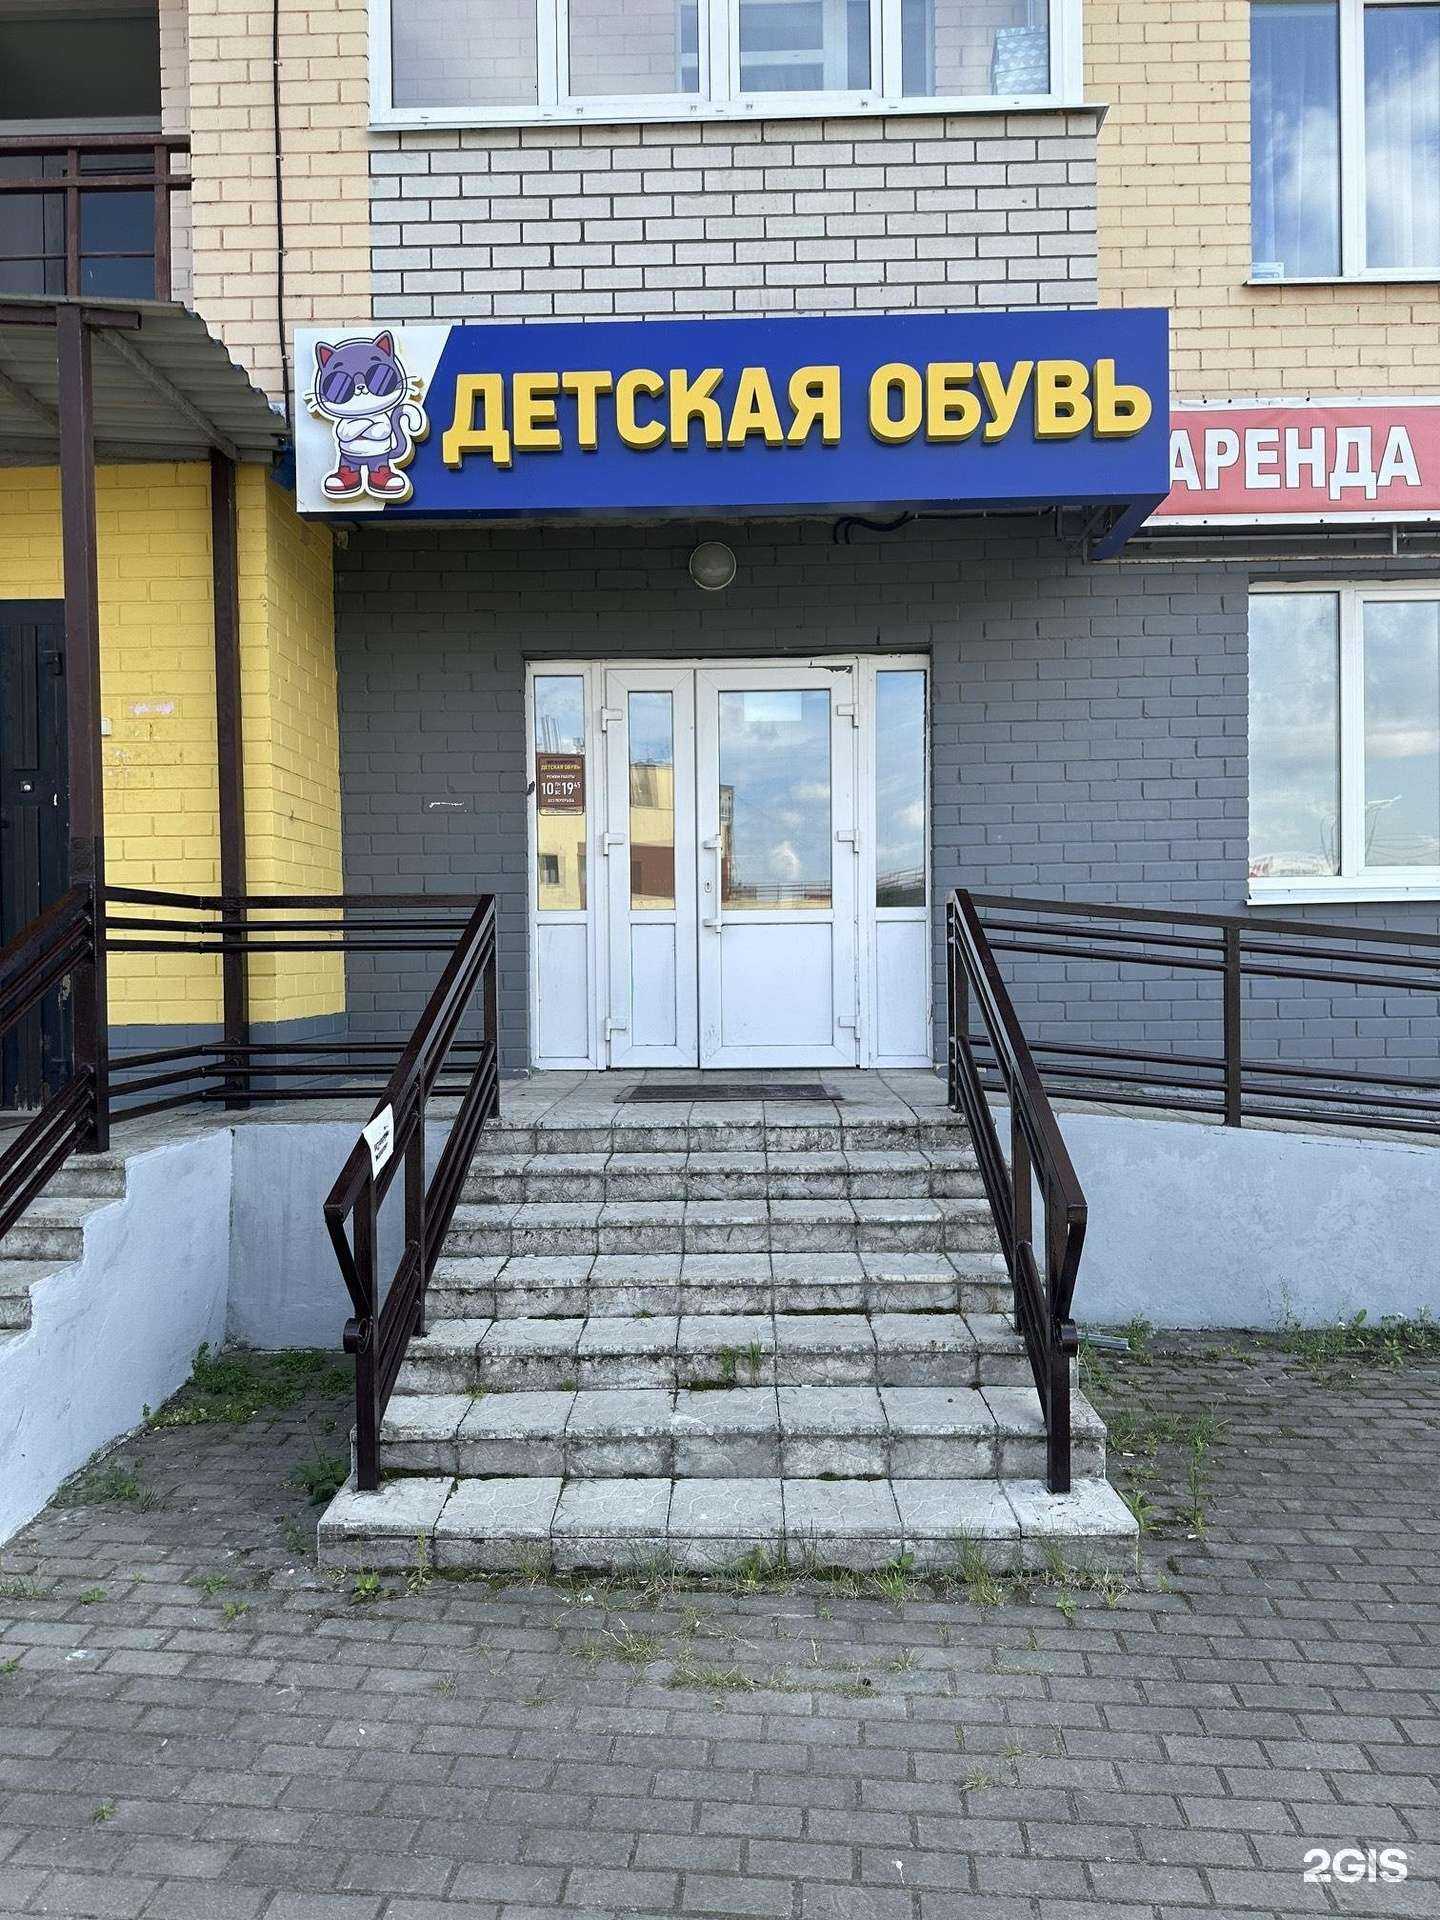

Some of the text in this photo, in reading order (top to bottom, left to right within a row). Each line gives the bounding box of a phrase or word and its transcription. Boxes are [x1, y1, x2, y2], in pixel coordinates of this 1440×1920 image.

[442, 358, 1152, 469] ДЕТСКАЯ ОБУВЬ
[1169, 426, 1423, 501] АРЕНДА
[541, 782, 554, 795] 10
